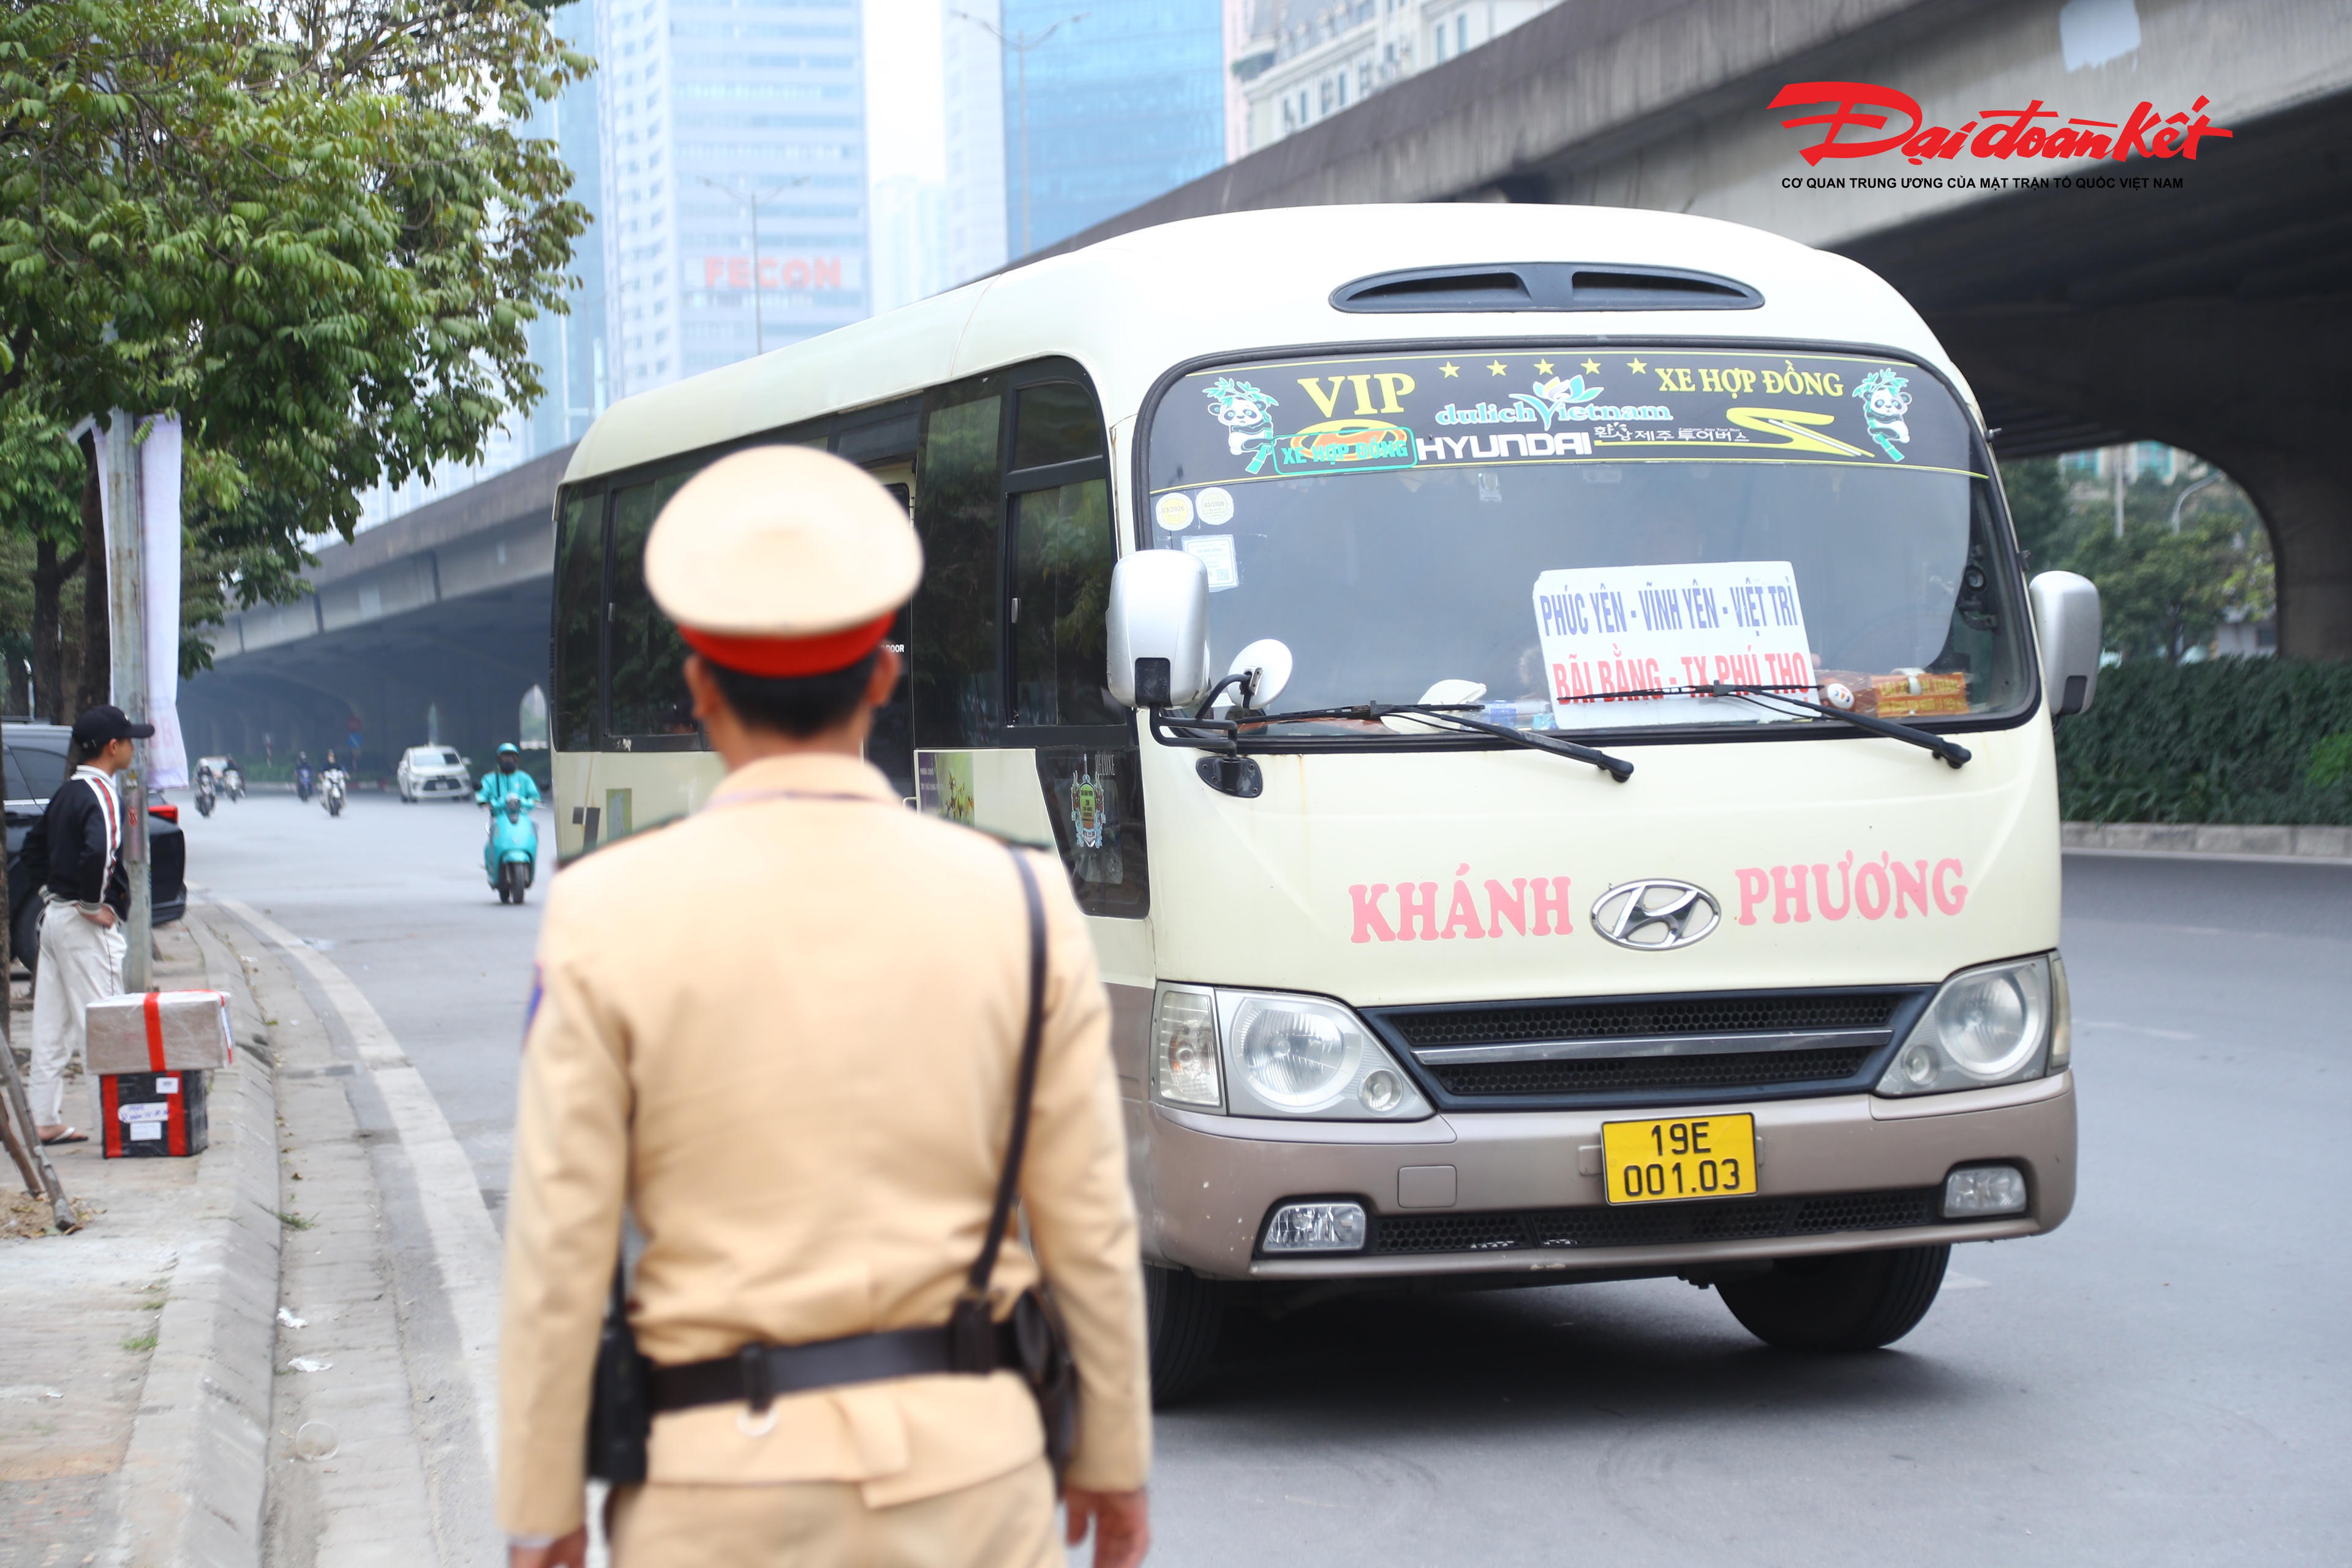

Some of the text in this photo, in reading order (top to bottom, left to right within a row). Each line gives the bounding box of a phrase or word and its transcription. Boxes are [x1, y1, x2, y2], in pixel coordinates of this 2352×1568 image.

[705, 256, 842, 288] FECON
[1297, 372, 1416, 418] VIP
[1654, 360, 1844, 399] XE HỢP ĐỒNG
[1281, 447, 1306, 465] XE
[1313, 442, 1350, 465] HỢP
[1415, 432, 1593, 461] HYUNDAI
[1540, 584, 1589, 636] PHÚC
[1589, 583, 1627, 633] YÊN
[1638, 581, 1683, 631] VĨNH
[1682, 579, 1719, 629] YÊN
[1730, 577, 1768, 637] VIỆT
[1767, 576, 1798, 626] TRÌ
[1552, 653, 1596, 704] BÃI
[1597, 643, 1664, 703] BẰNG
[1669, 677, 1677, 685] -
[1714, 644, 1762, 696] PHÚ
[1764, 651, 1809, 703] THỌ
[1095, 754, 1115, 776] DELUXE
[1348, 850, 1969, 944] KHÁNH PHƯƠNG
[1651, 1121, 1711, 1156] 19E
[1624, 1158, 1740, 1197] 001.03
